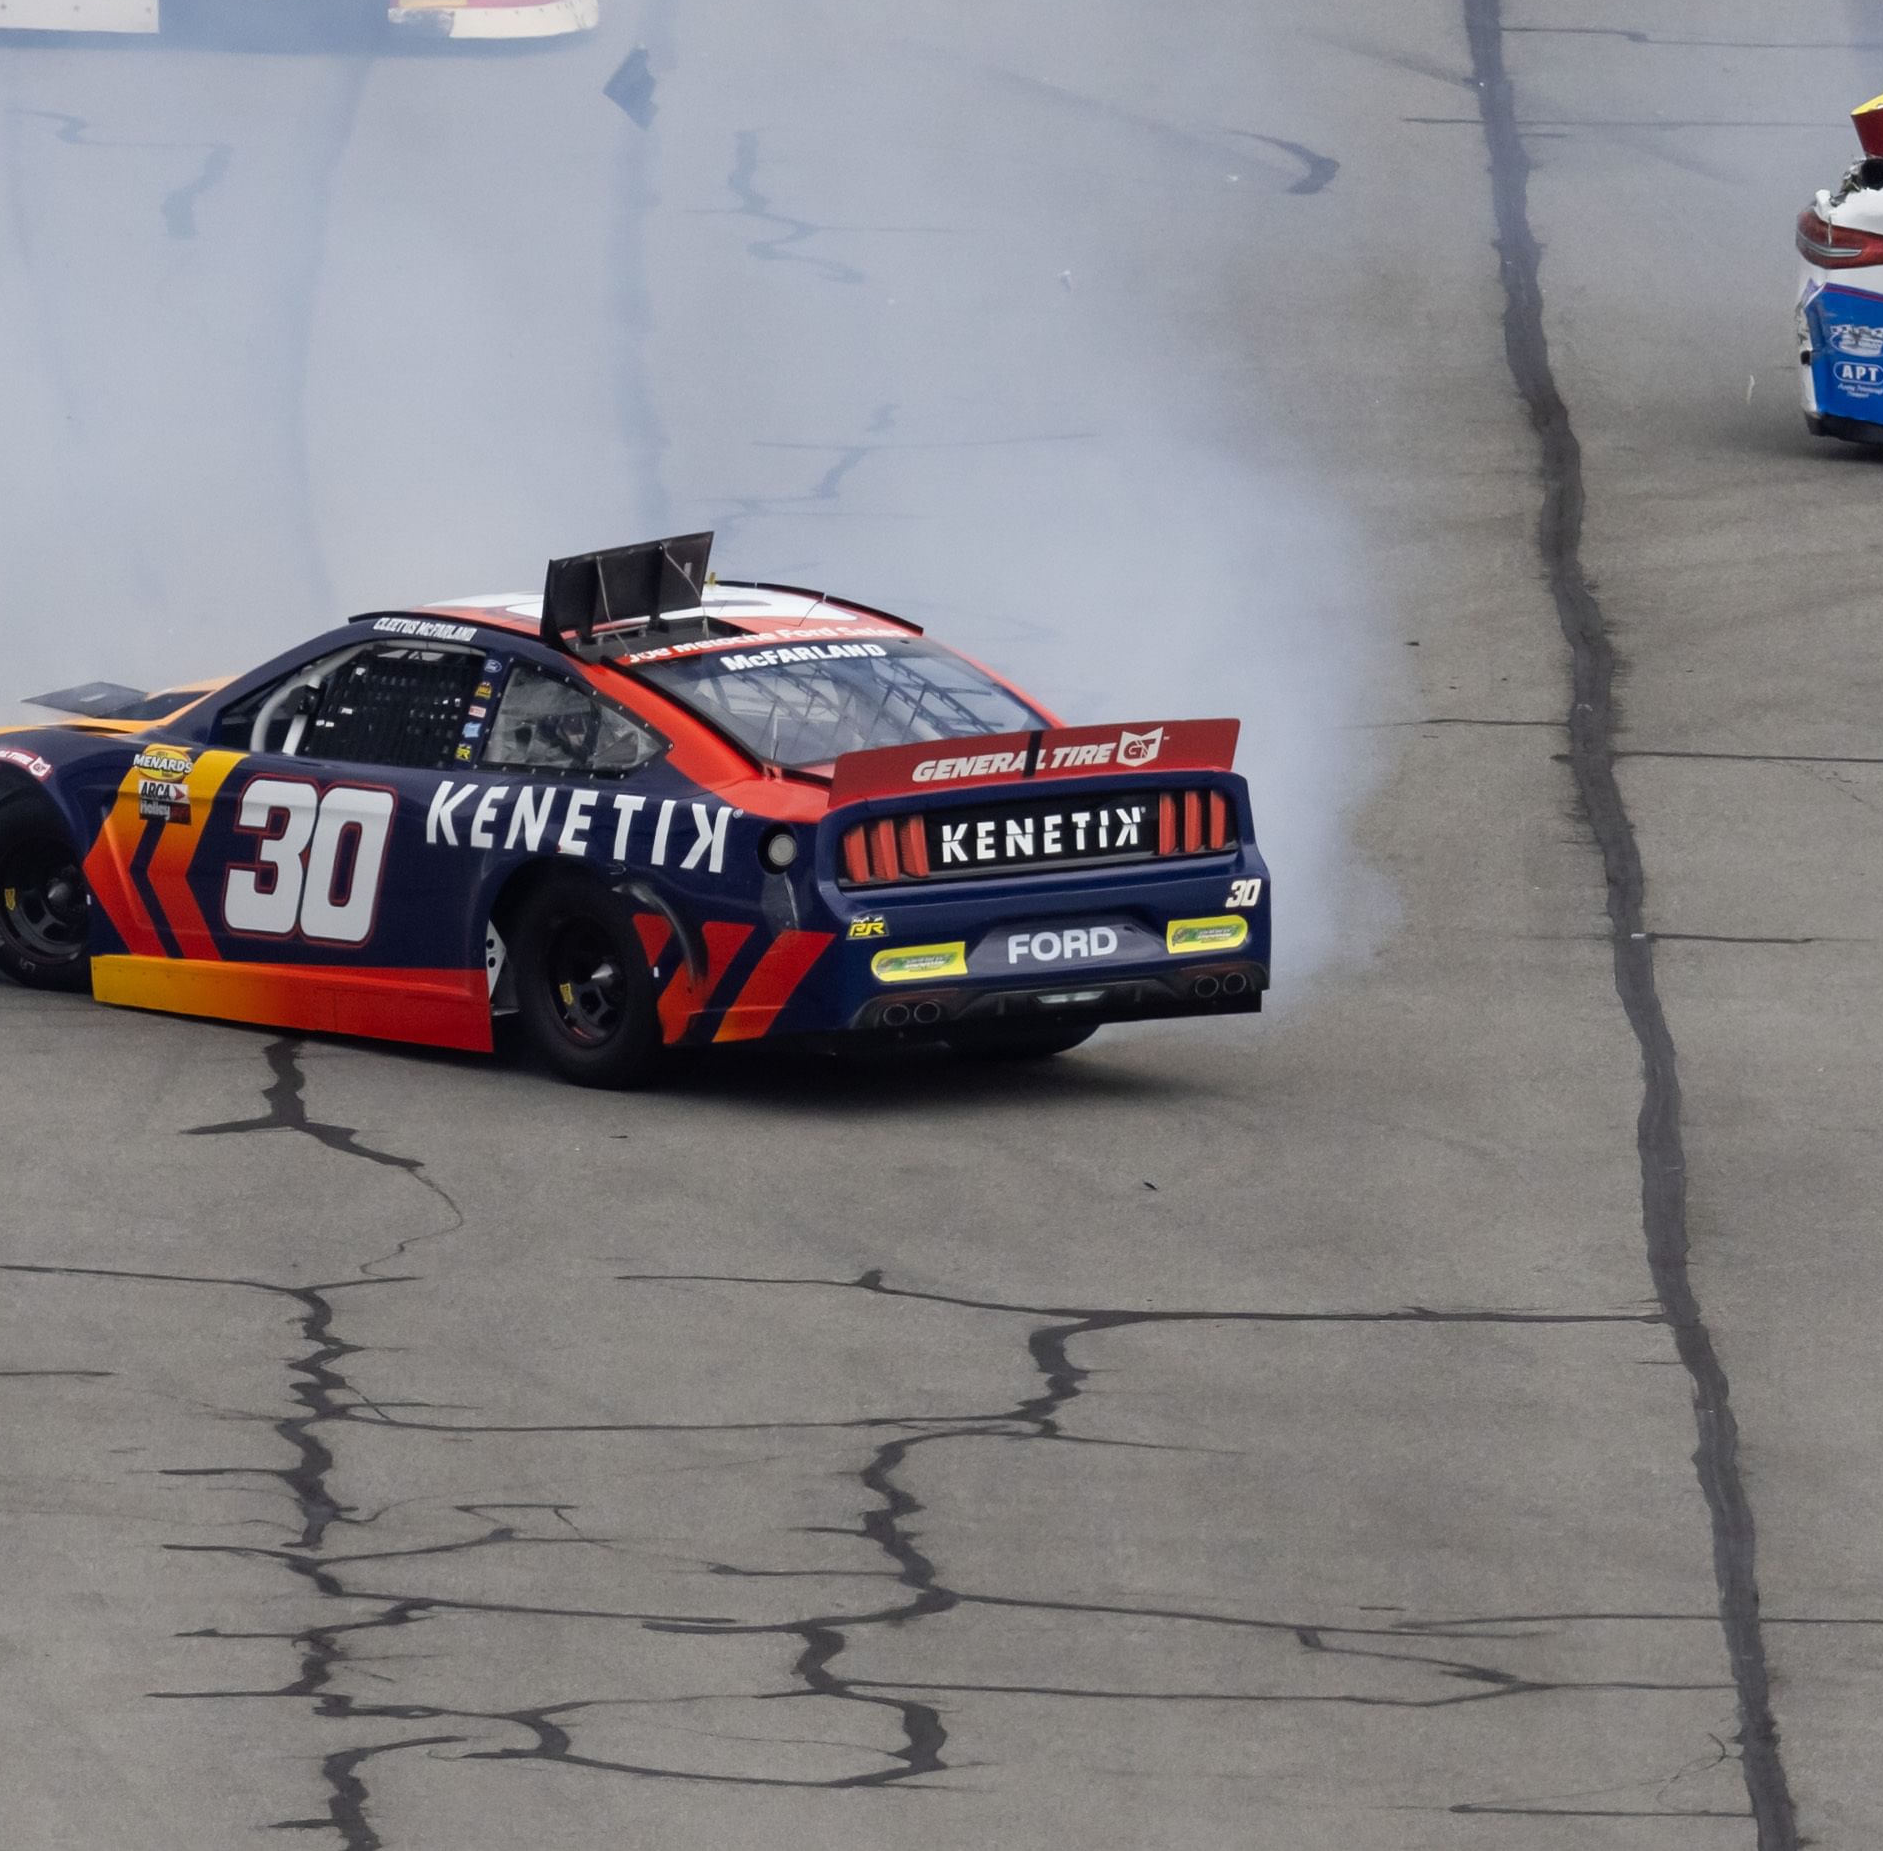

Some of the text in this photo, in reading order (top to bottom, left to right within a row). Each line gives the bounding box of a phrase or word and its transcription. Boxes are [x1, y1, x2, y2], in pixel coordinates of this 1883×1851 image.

[1842, 364, 1879, 382] APT
[373, 617, 478, 641] CLEETUS McFARLAND
[775, 627, 838, 638] Ford
[836, 627, 908, 637] Sales
[720, 643, 888, 671] McFARLAND
[133, 754, 193, 774] MENARDS
[912, 748, 1046, 782] GENERAL
[1049, 742, 1117, 769] TIRE
[141, 781, 171, 800] ARCA
[426, 781, 733, 873] KENETIK
[942, 806, 1142, 863] KENETIK
[214, 774, 399, 945] 30
[1225, 879, 1262, 908] 30
[1007, 927, 1118, 963] FORD
